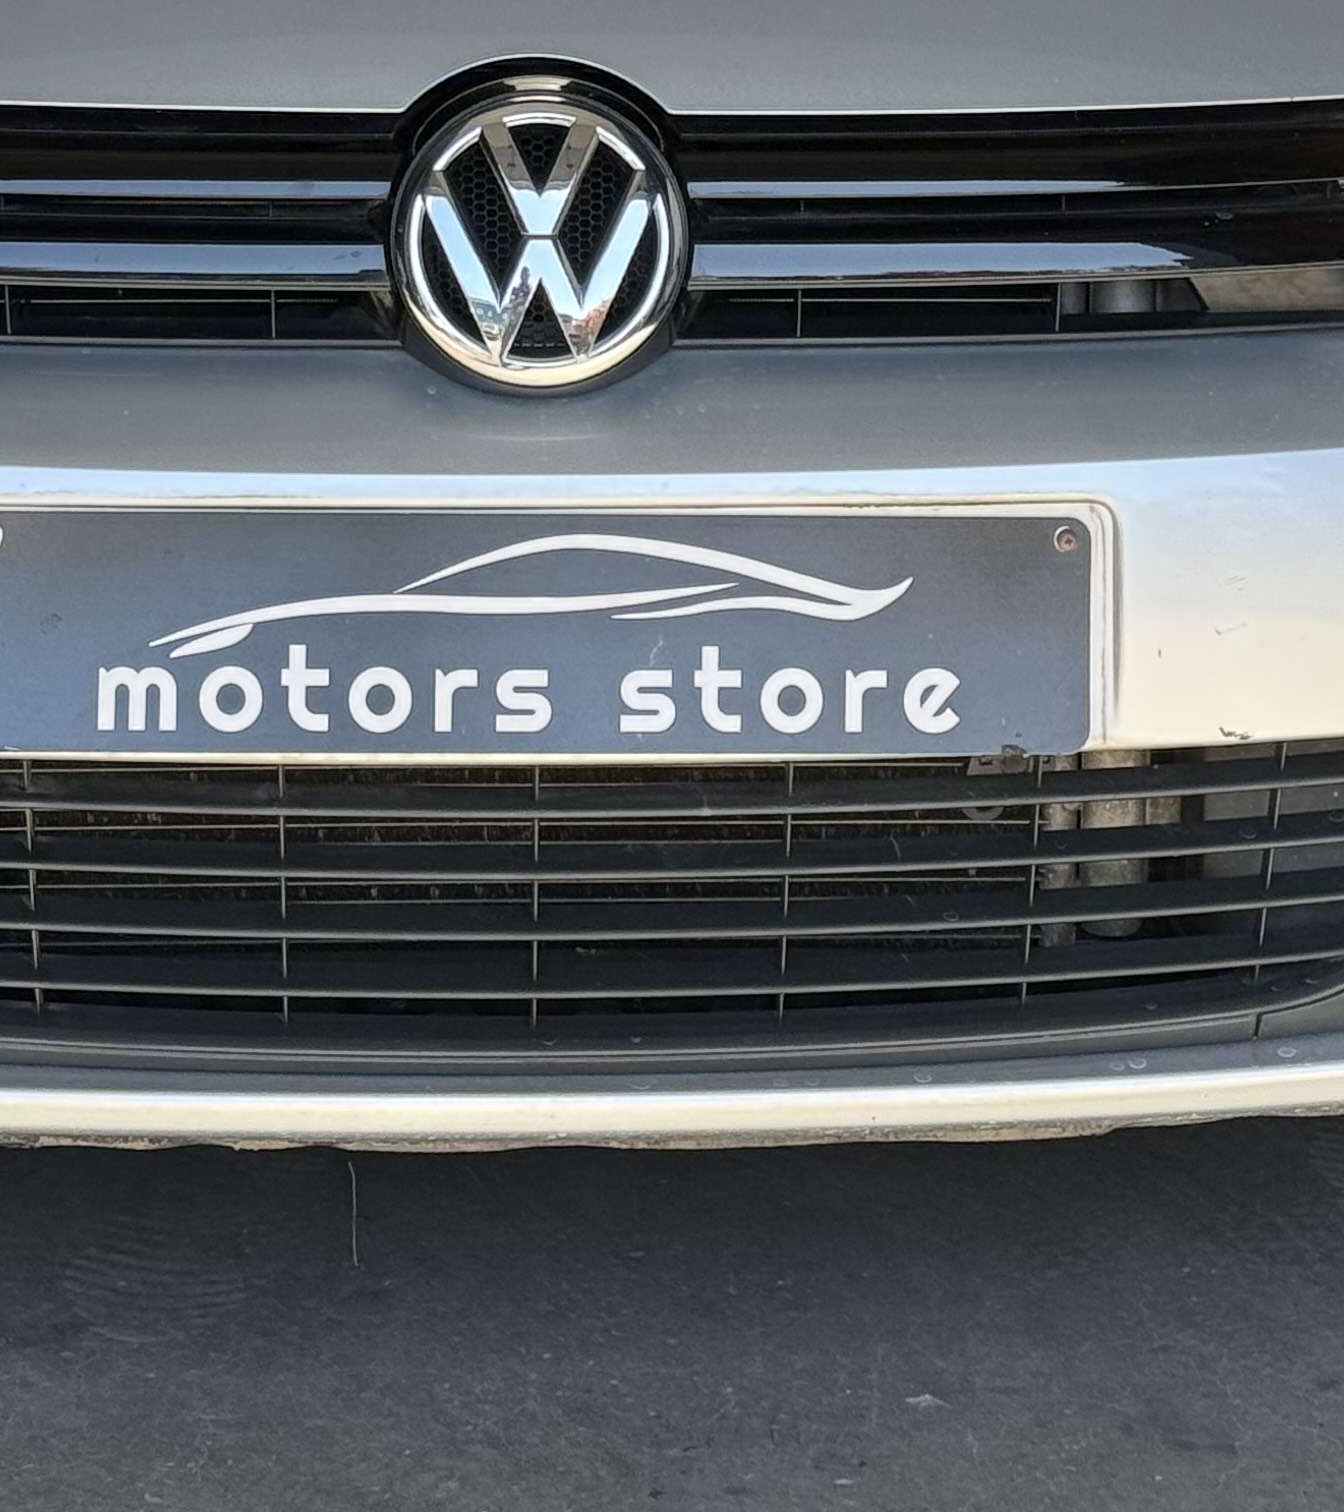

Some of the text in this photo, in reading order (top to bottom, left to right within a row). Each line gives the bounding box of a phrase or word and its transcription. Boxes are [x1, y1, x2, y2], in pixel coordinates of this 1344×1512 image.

[420, 116, 659, 364] VW
[97, 644, 961, 734] motors store
